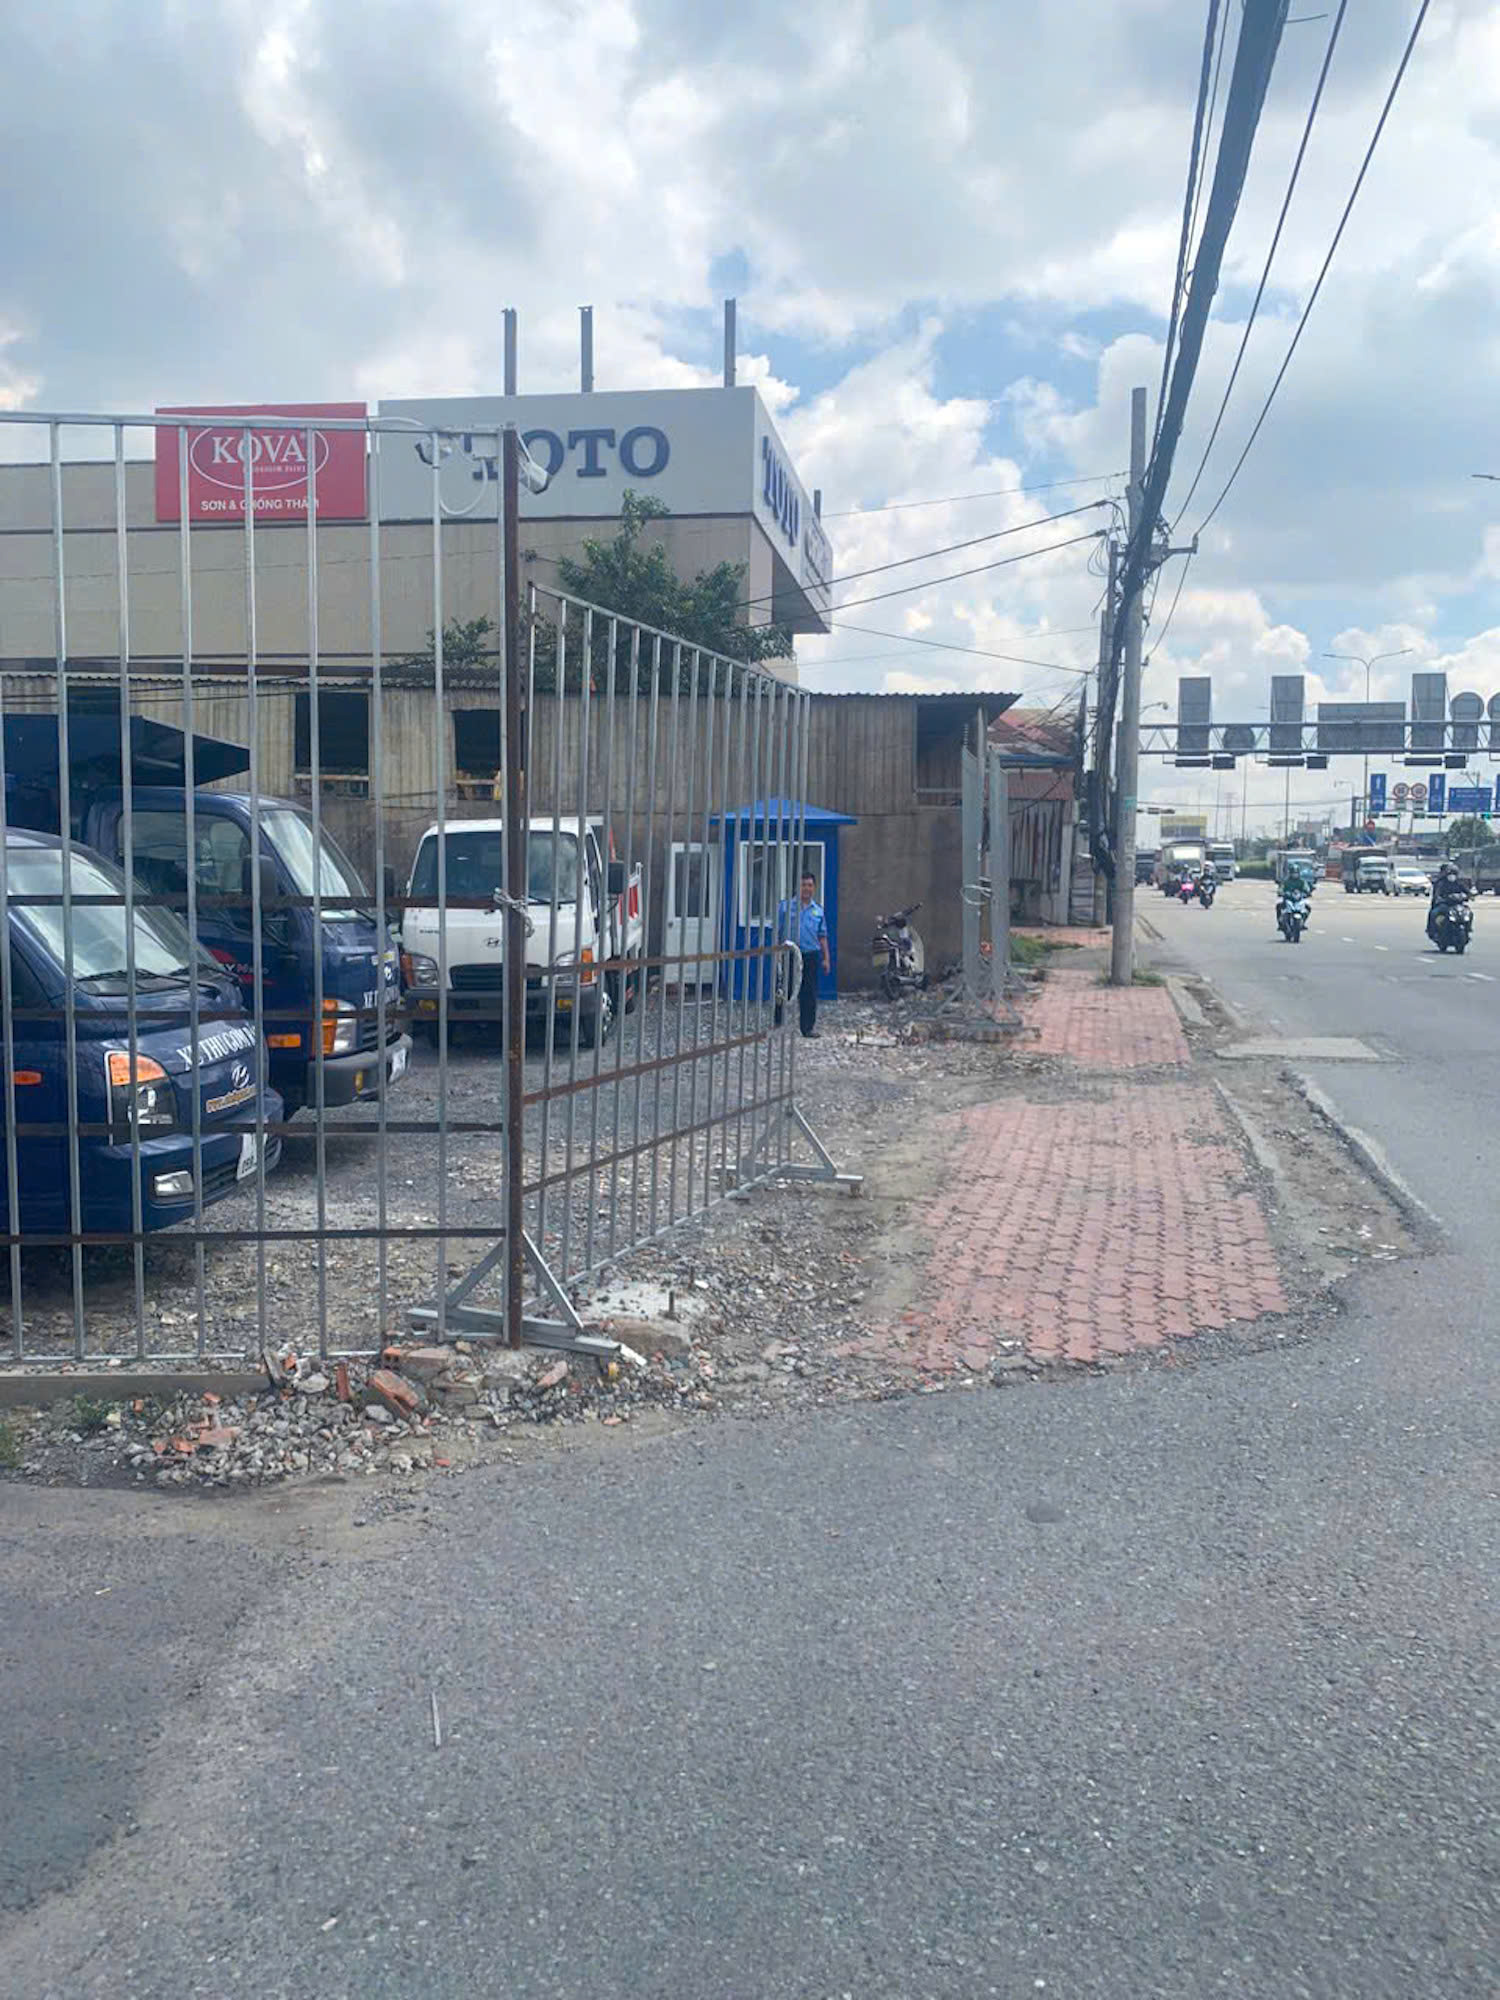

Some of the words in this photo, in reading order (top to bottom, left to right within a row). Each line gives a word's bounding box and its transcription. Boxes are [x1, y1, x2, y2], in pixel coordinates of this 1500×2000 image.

[211, 436, 306, 463] KOVA
[463, 427, 670, 480] OTO
[229, 500, 237, 511] &
